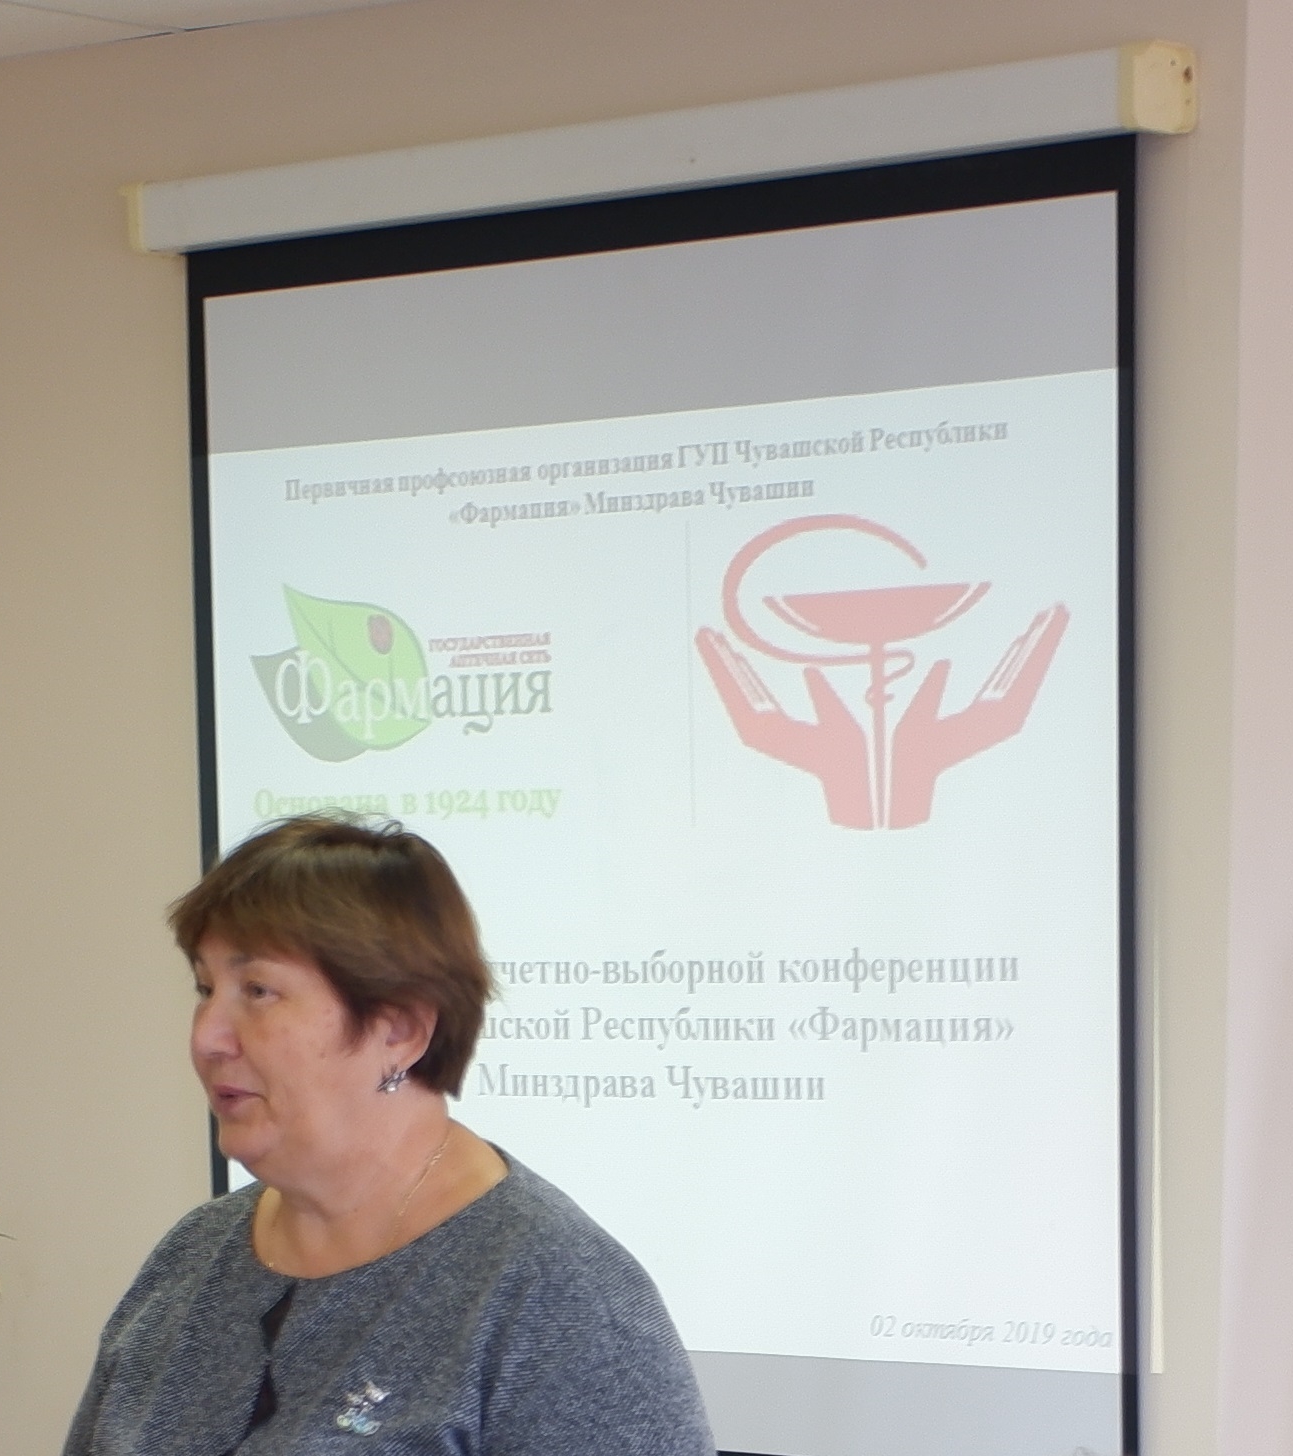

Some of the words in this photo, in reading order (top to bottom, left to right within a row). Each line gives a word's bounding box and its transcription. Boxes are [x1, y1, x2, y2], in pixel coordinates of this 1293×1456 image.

[285, 478, 394, 504] Первичная
[398, 464, 531, 496] профсоюзная
[537, 452, 674, 485] организация
[676, 440, 729, 468] ГУП
[735, 431, 866, 468] Чувашской
[869, 419, 1009, 453] Республики
[449, 500, 581, 528] «Фармация»
[584, 489, 705, 514] Минздрава
[708, 480, 814, 510] Чувашии
[274, 649, 554, 742] Фармация
[426, 788, 490, 820] 1924
[498, 788, 563, 820] году
[491, 948, 766, 995] четно-выборной
[778, 947, 1020, 995] конференции
[580, 1006, 776, 1051] Республики
[788, 1006, 1015, 1053] «Фармация»
[477, 1063, 658, 1108] Минздрава
[665, 1065, 825, 1109] Чувашии
[870, 1314, 896, 1338] 02
[901, 1318, 995, 1346] октября
[1001, 1320, 1056, 1345] 2019
[1060, 1328, 1114, 1348] года
